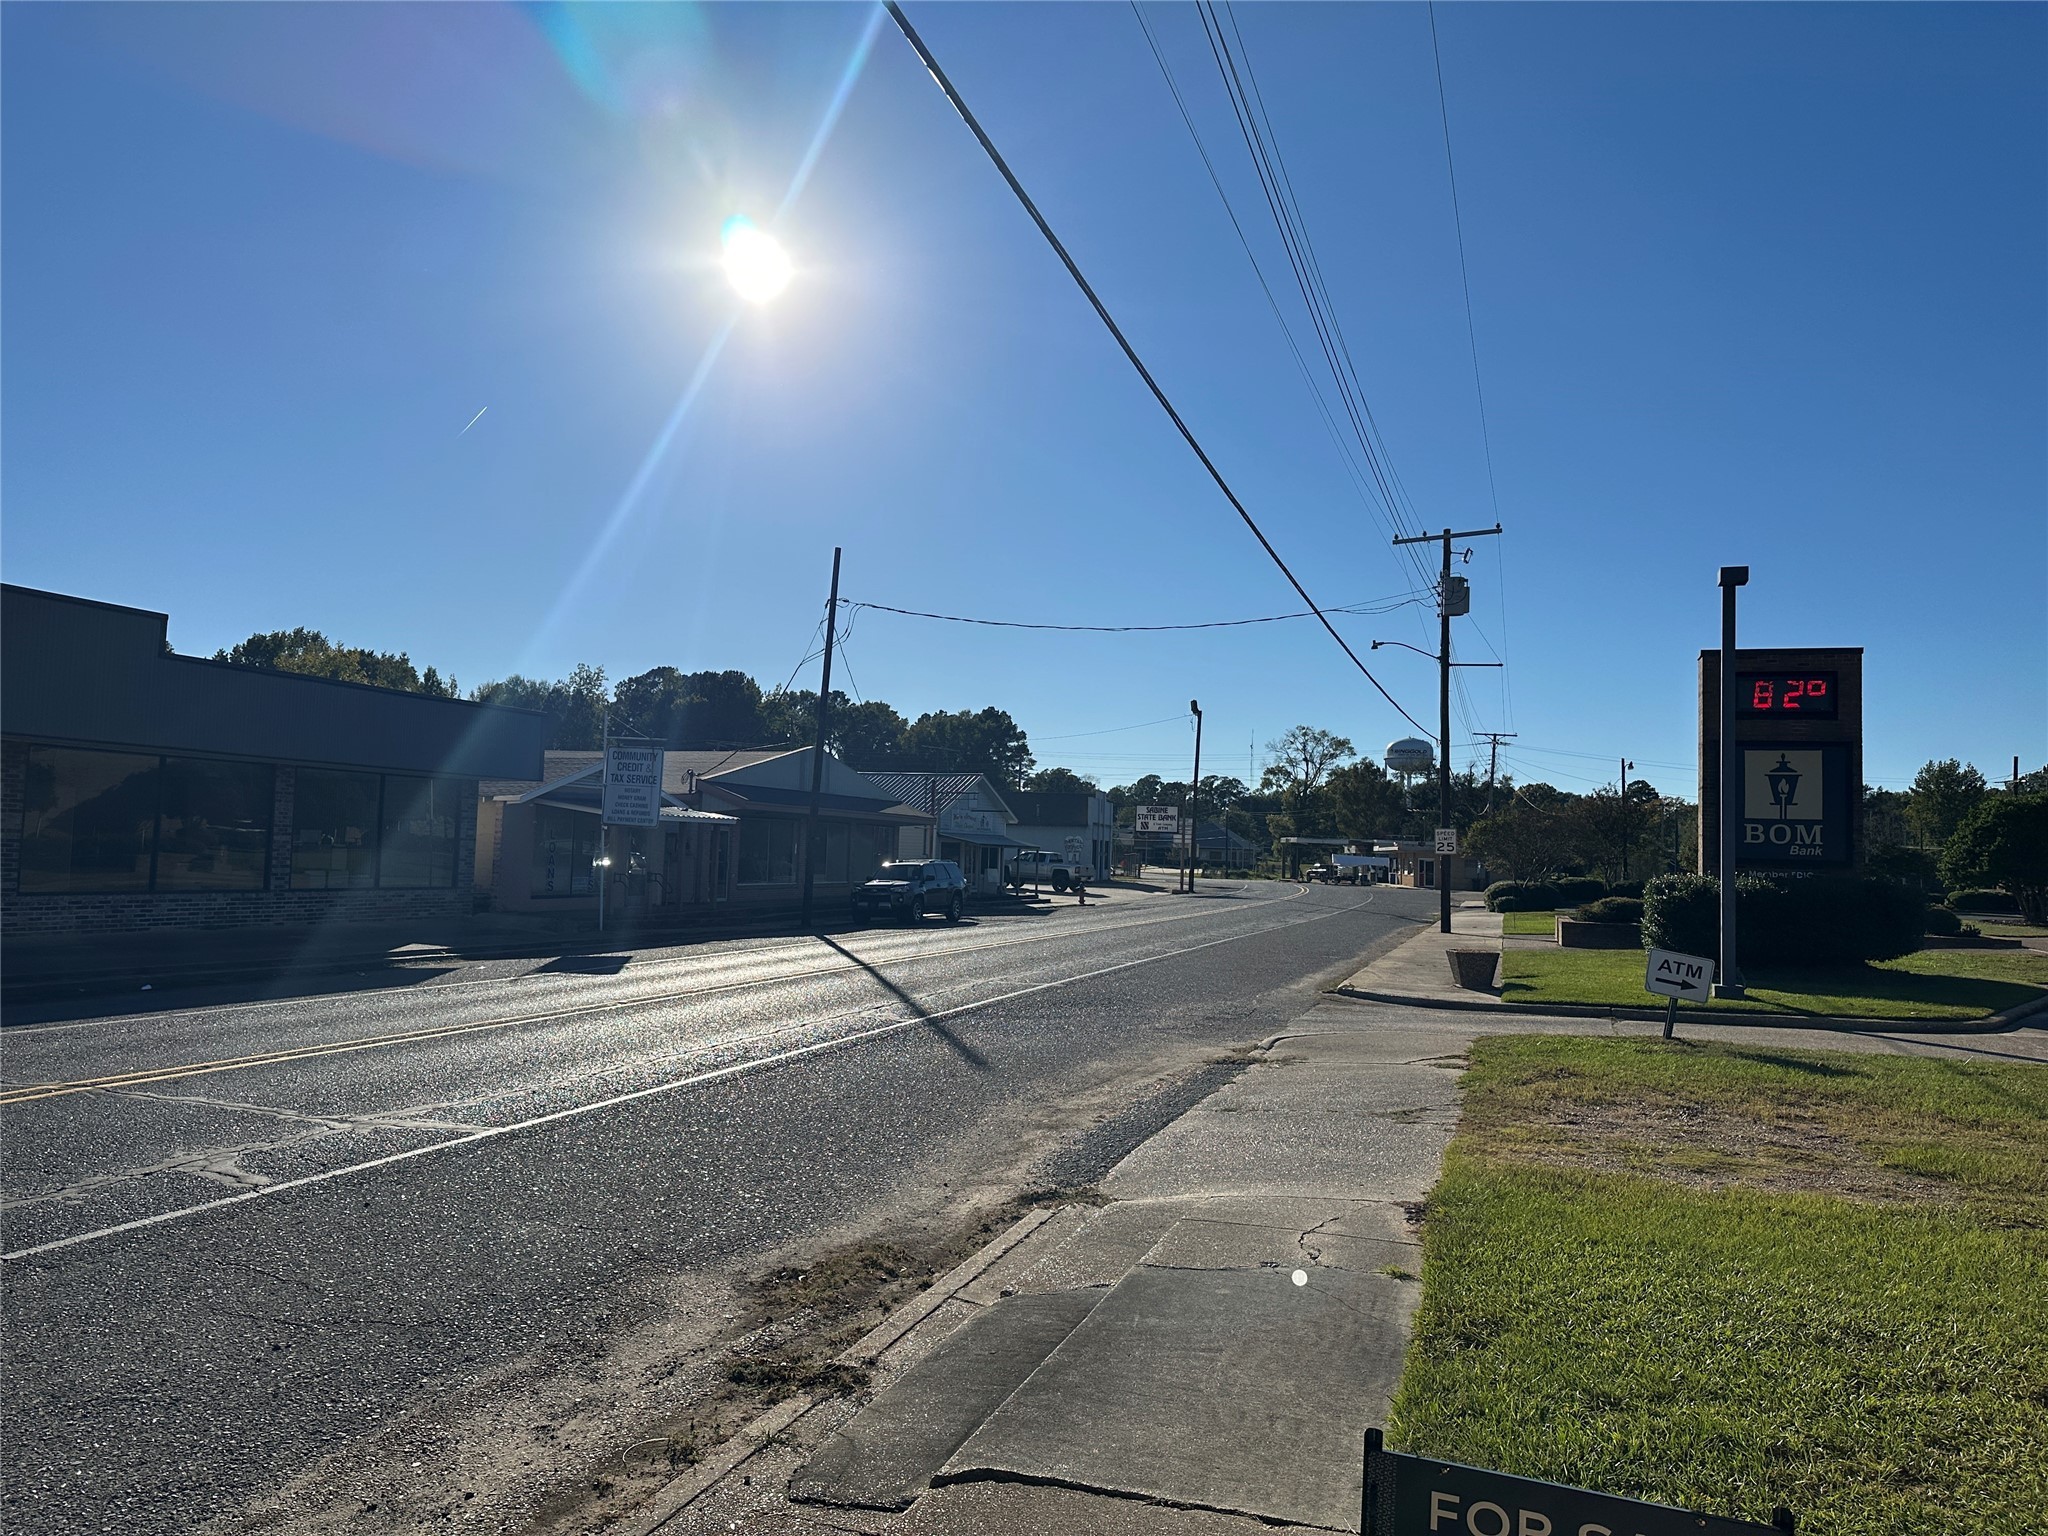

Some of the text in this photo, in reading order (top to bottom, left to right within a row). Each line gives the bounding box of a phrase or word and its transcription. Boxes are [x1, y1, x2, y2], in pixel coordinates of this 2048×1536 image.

[613, 751, 658, 762] COMMUNITY
[617, 762, 652, 773] CREDIT &
[610, 773, 658, 785] TAX SERVICE
[1146, 806, 1168, 814] SABINE
[1137, 813, 1157, 821] STATE
[1744, 823, 1824, 845] BOM
[1437, 842, 1455, 852] 25
[1789, 845, 1823, 856] Bank
[547, 829, 556, 892] LOANS
[1657, 958, 1703, 980] ATM
[1429, 1490, 1553, 1536] FOR
